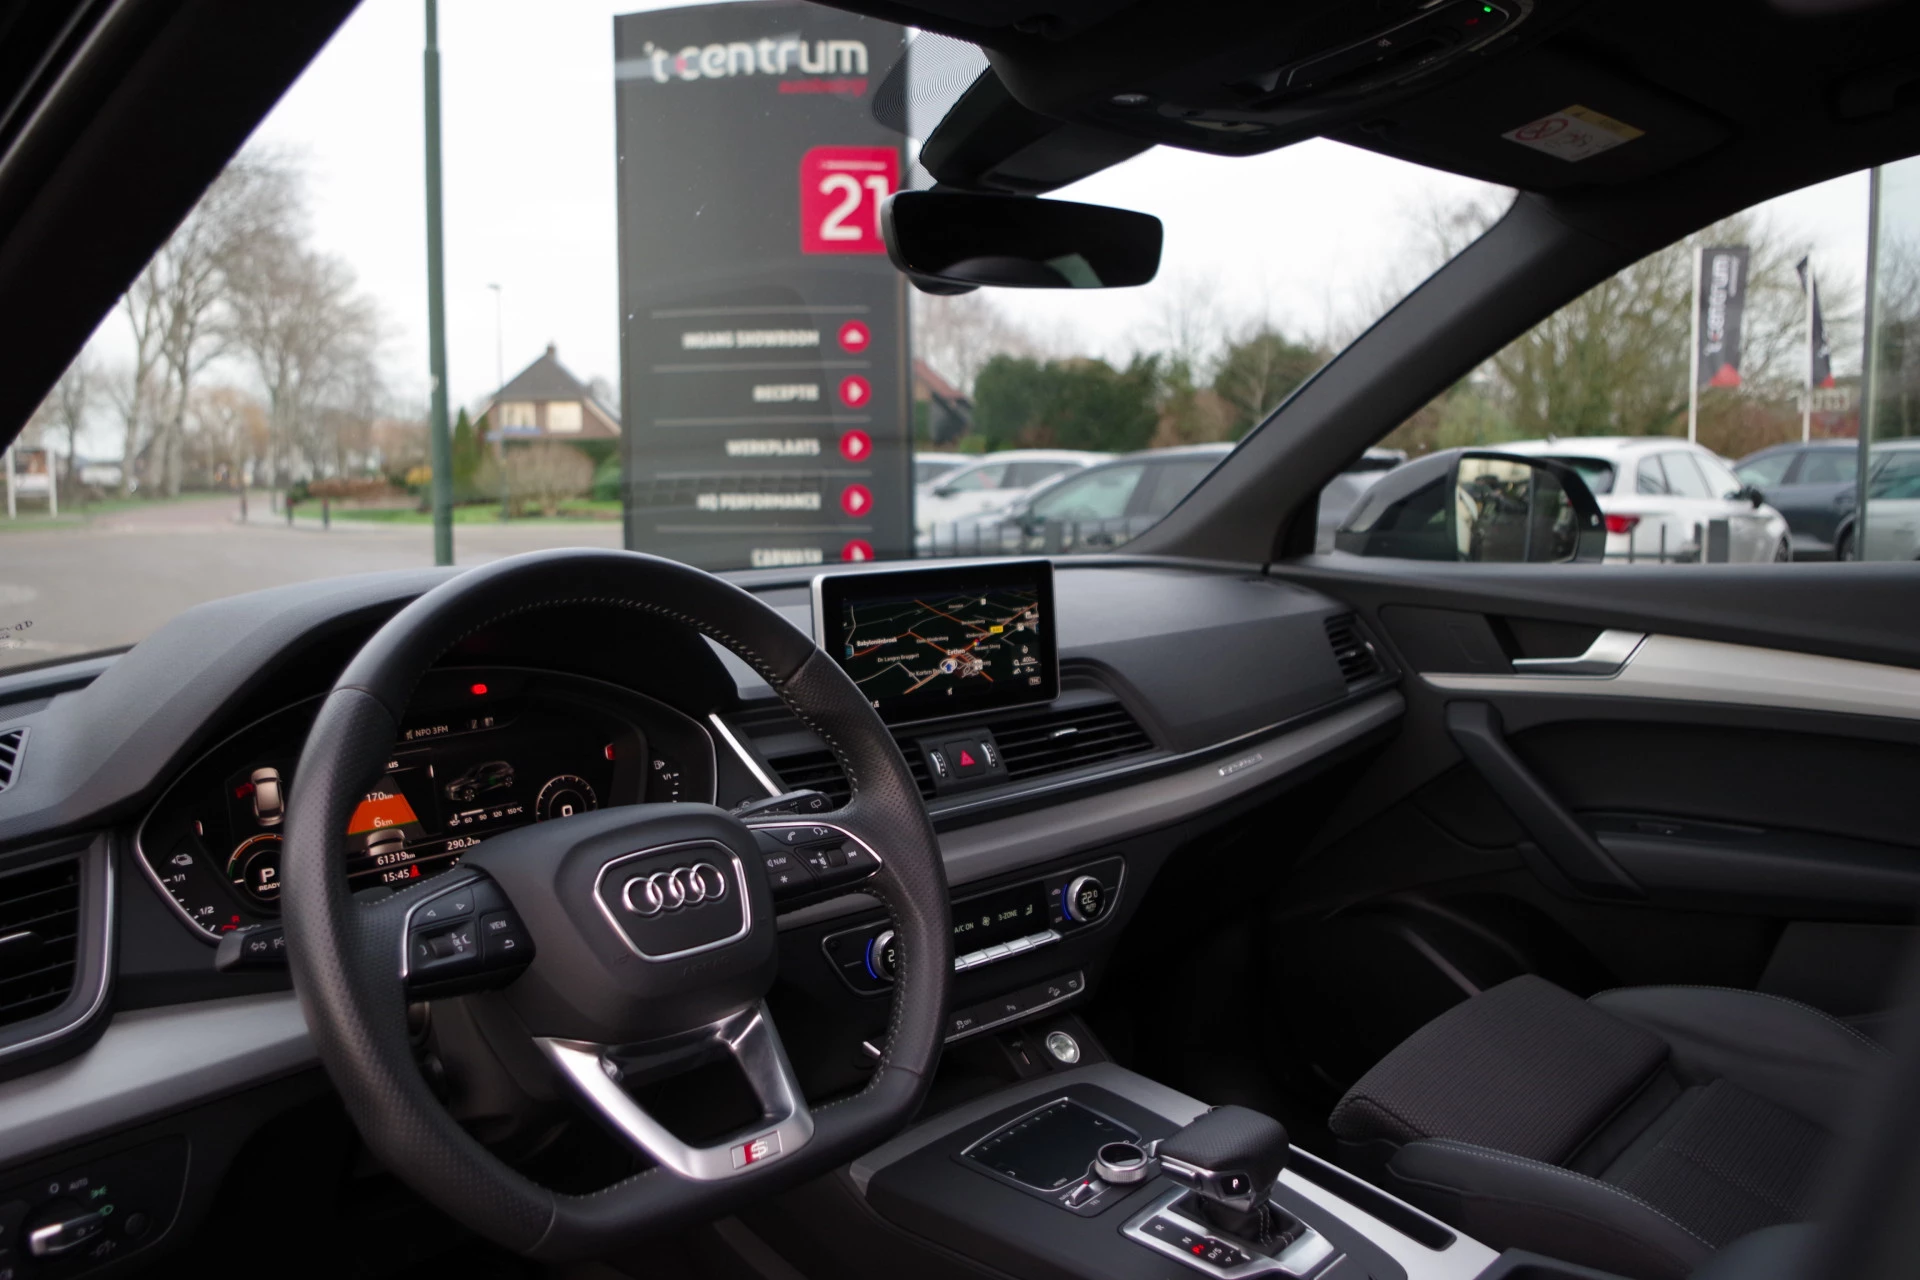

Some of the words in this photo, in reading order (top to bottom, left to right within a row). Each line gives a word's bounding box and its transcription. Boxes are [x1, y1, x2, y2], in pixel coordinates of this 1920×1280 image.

[819, 172, 888, 241] 21
[414, 729, 431, 738] NPO
[261, 867, 275, 884] P
[383, 869, 410, 883] 15:45
[1232, 1178, 1240, 1190] P
